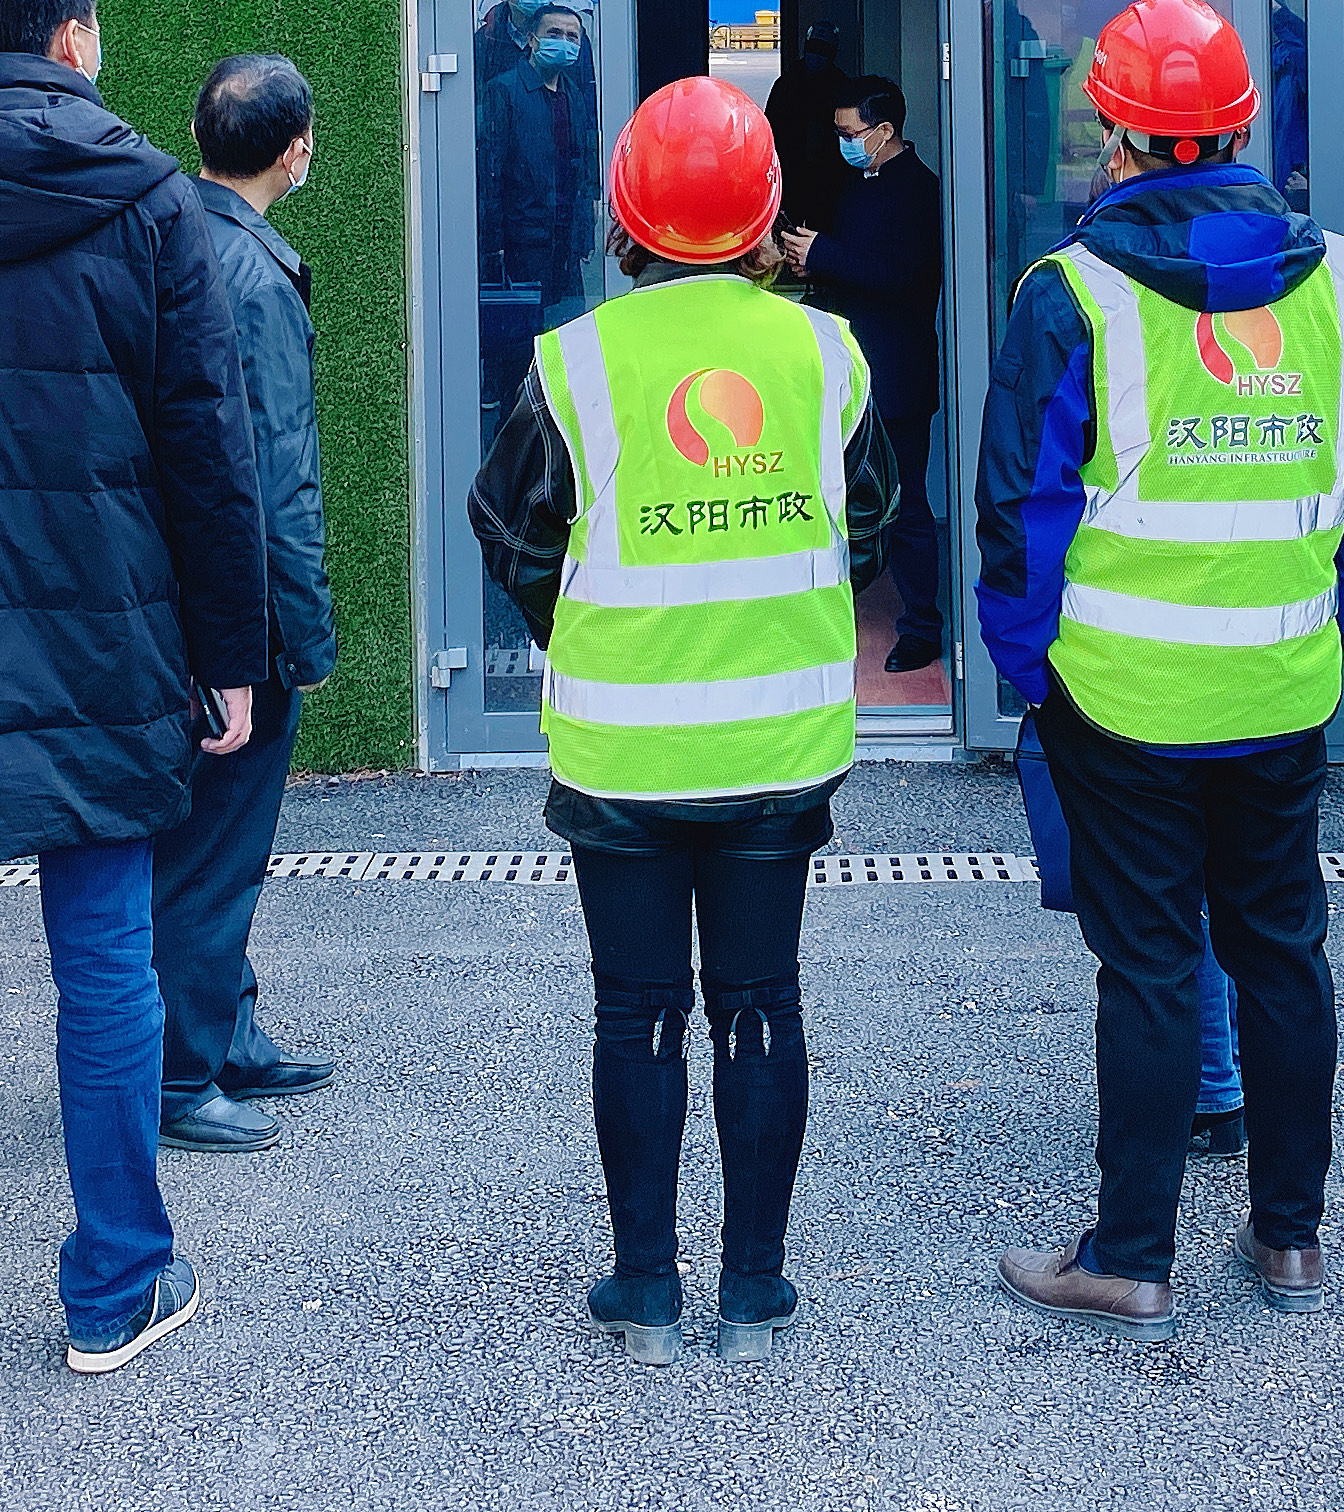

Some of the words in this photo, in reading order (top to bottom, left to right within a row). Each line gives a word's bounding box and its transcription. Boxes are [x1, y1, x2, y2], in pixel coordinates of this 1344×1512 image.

[1238, 374, 1302, 396] HYSZ
[1167, 414, 1324, 449] 汉阳市政
[714, 451, 785, 478] HYSZ
[1169, 453, 1227, 465] HANYANG
[1230, 449, 1317, 463] INFRASTRUCRE
[639, 491, 815, 535] 汉阳市政
